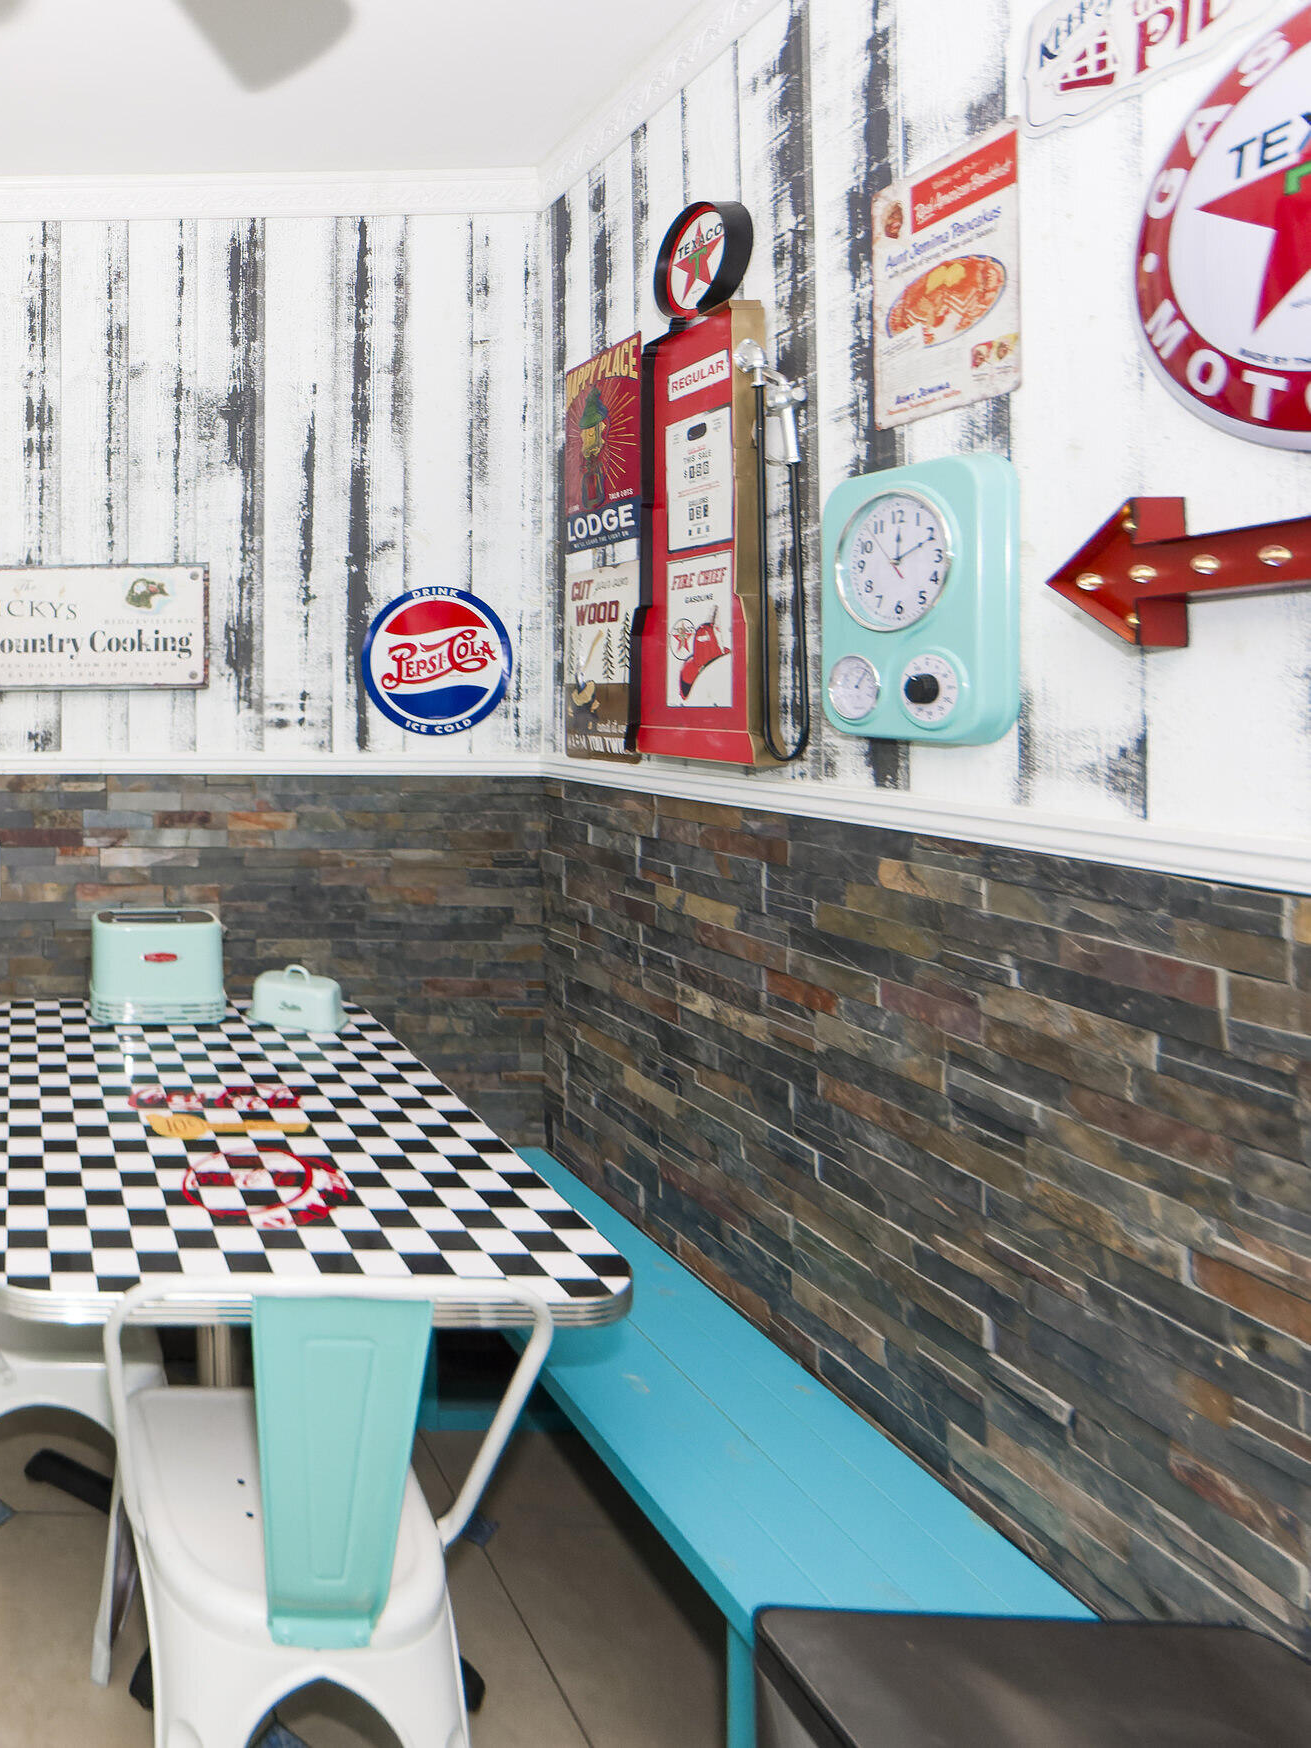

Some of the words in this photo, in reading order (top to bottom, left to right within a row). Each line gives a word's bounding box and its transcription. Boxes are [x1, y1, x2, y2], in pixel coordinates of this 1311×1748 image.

[677, 222, 723, 259] TEXACO
[1144, 298, 1311, 421] MOT
[567, 358, 599, 409] HAPPY
[597, 337, 638, 380] PLACE
[671, 359, 725, 393] REGULAR
[567, 503, 635, 542] LODGE
[891, 509, 905, 525] 12
[916, 512, 921, 527] 1
[873, 520, 884, 535] 11
[926, 526, 936, 542] 2
[861, 540, 874, 555] 10
[934, 548, 944, 564] 3
[857, 560, 866, 574] 9
[671, 572, 695, 591] FIRE
[697, 566, 728, 586] CHIEF
[930, 570, 939, 585] 4
[411, 587, 460, 599] DRINK
[571, 578, 594, 601] CUT
[864, 579, 874, 594] 8
[684, 593, 714, 604] GASOLINE
[875, 594, 883, 609] 7
[918, 590, 927, 605] 5
[576, 600, 620, 626] WOOD
[894, 600, 904, 615] 6
[89, 628, 193, 660] Cooking
[405, 719, 428, 733] ICE
[434, 718, 472, 734] COLD
